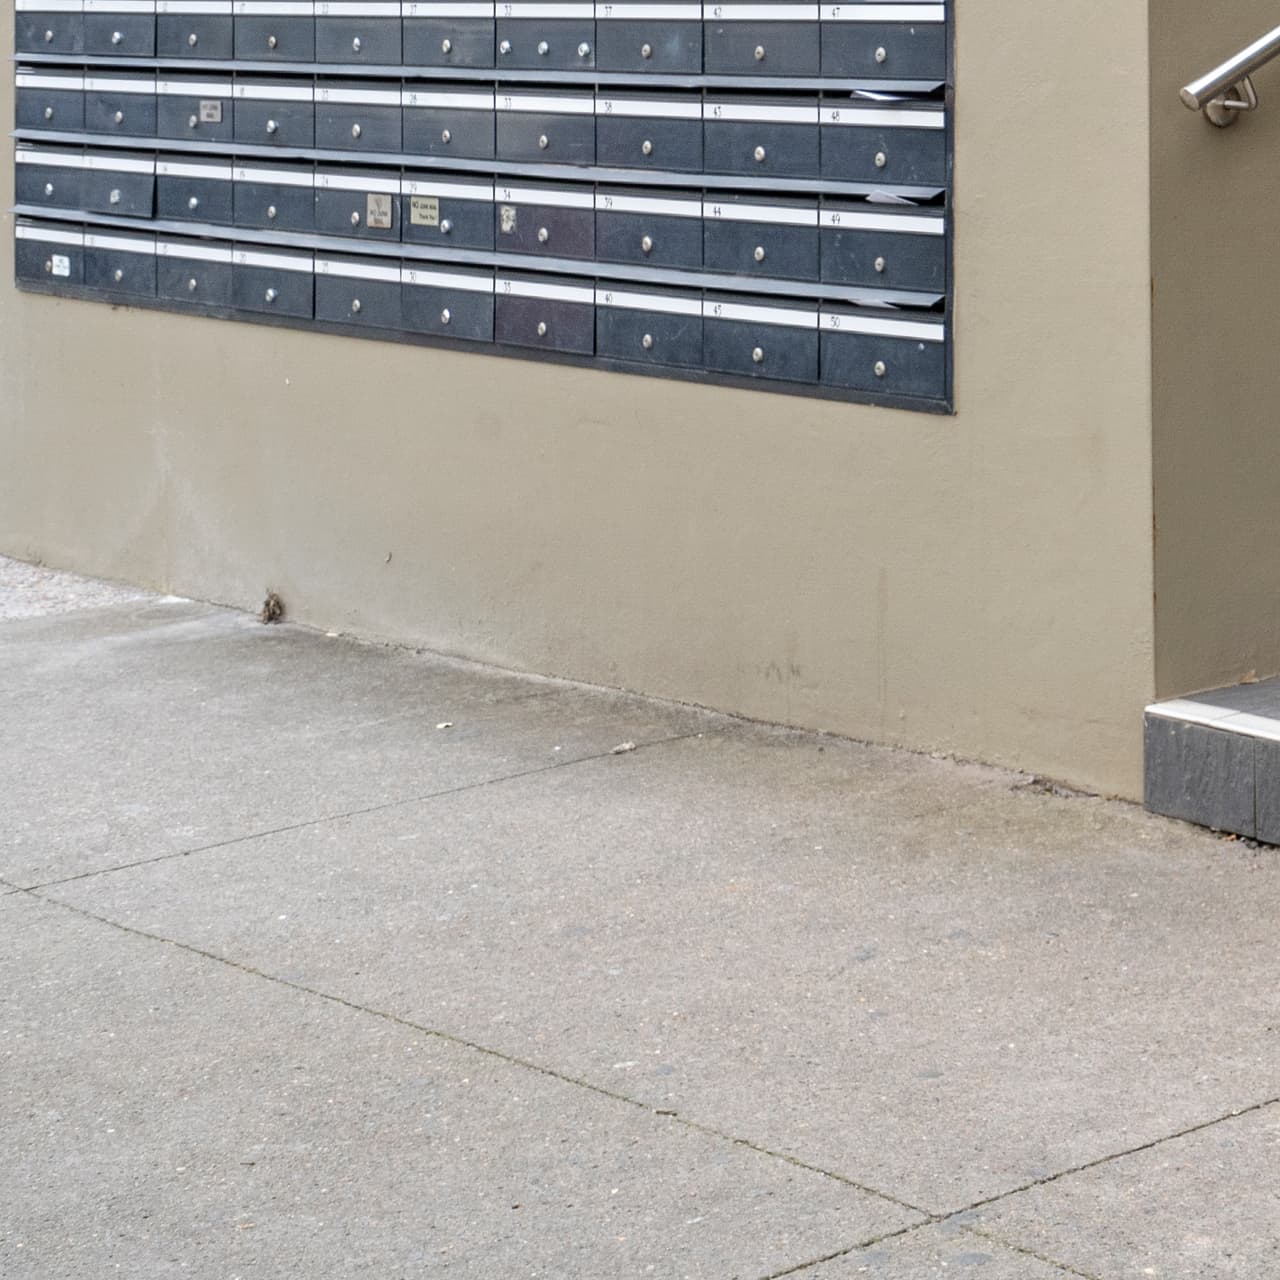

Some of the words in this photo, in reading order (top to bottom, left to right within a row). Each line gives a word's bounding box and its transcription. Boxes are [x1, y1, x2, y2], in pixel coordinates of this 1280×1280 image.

[832, 7, 840, 18] 47
[832, 110, 840, 121] 48
[713, 206, 721, 216] 44
[832, 213, 840, 224] 49
[831, 315, 841, 327] 50
